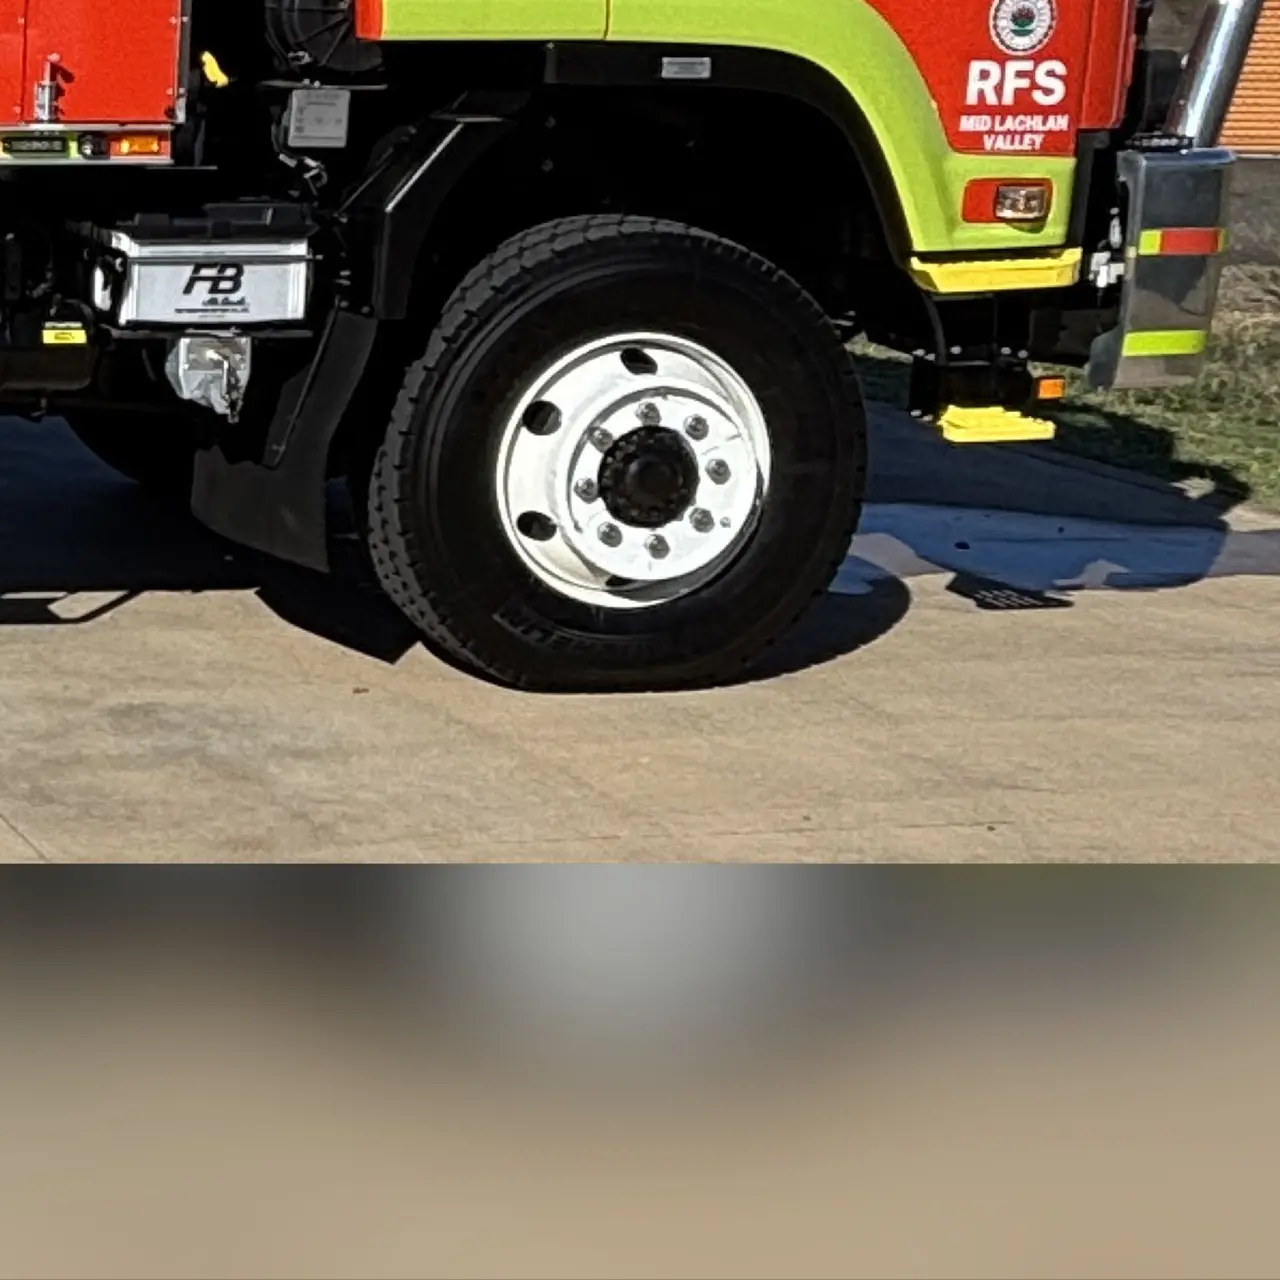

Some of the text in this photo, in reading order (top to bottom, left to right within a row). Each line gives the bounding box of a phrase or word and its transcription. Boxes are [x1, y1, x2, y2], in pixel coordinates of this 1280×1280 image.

[964, 59, 1068, 107] RFS
[959, 114, 1070, 132] MID LACHLAN
[983, 134, 1046, 151] VALLEY
[182, 262, 244, 295] FB
